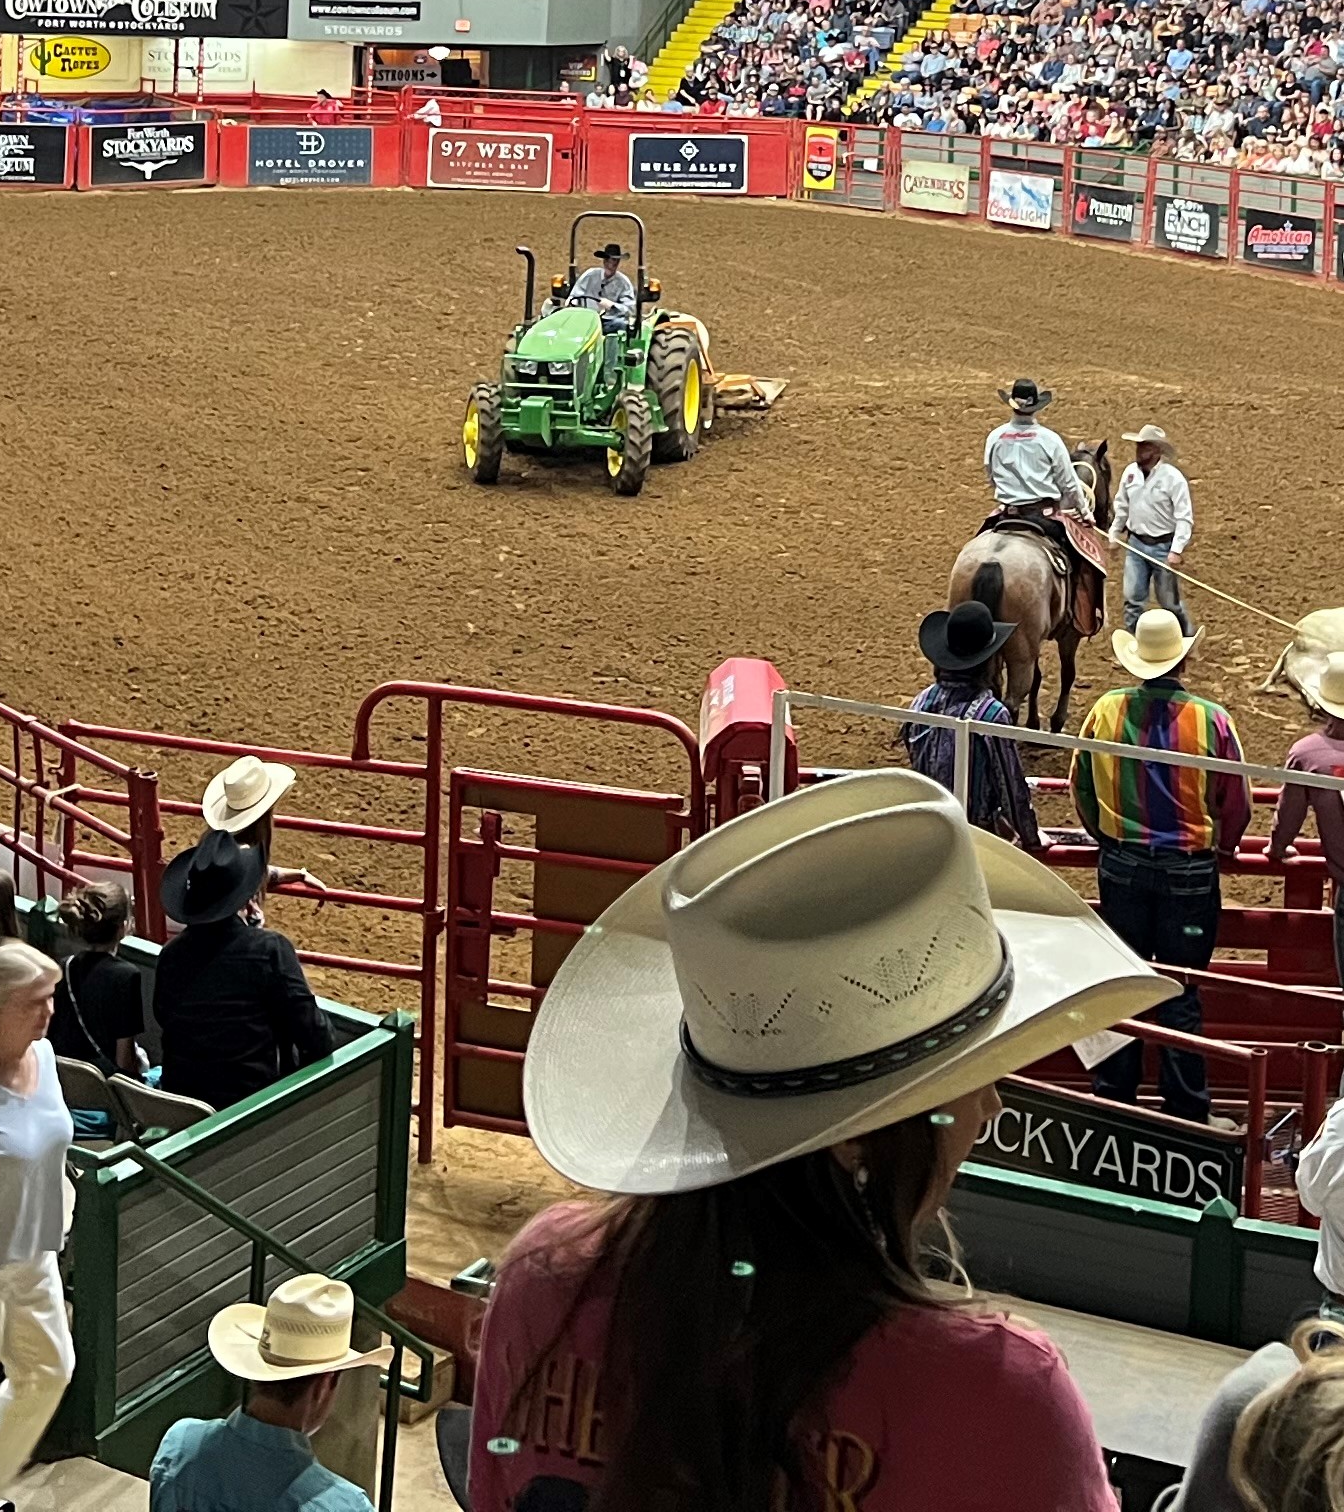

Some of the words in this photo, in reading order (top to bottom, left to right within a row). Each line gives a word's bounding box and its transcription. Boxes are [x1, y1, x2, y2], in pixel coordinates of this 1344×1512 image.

[38, 19, 65, 28] FORT
[69, 19, 106, 29] WORTH
[324, 25, 403, 36] STOCKYARDS
[54, 43, 98, 57] CACTUS
[148, 49, 241, 61] STOKARDS
[60, 58, 100, 71] ROPES
[373, 69, 425, 82] ESTROOMS
[103, 136, 194, 158] STOCKYARDS
[441, 140, 467, 158] 97
[477, 142, 541, 160] WEST
[255, 159, 301, 168] HOTEL
[308, 159, 365, 168] DROVER
[640, 163, 682, 172] MULE
[688, 163, 738, 173] ALLEY
[903, 174, 965, 200] CAVENDER'S
[989, 199, 1020, 220] Coors
[1020, 209, 1049, 224] LIGHT
[1089, 198, 1133, 222] PENDLETON
